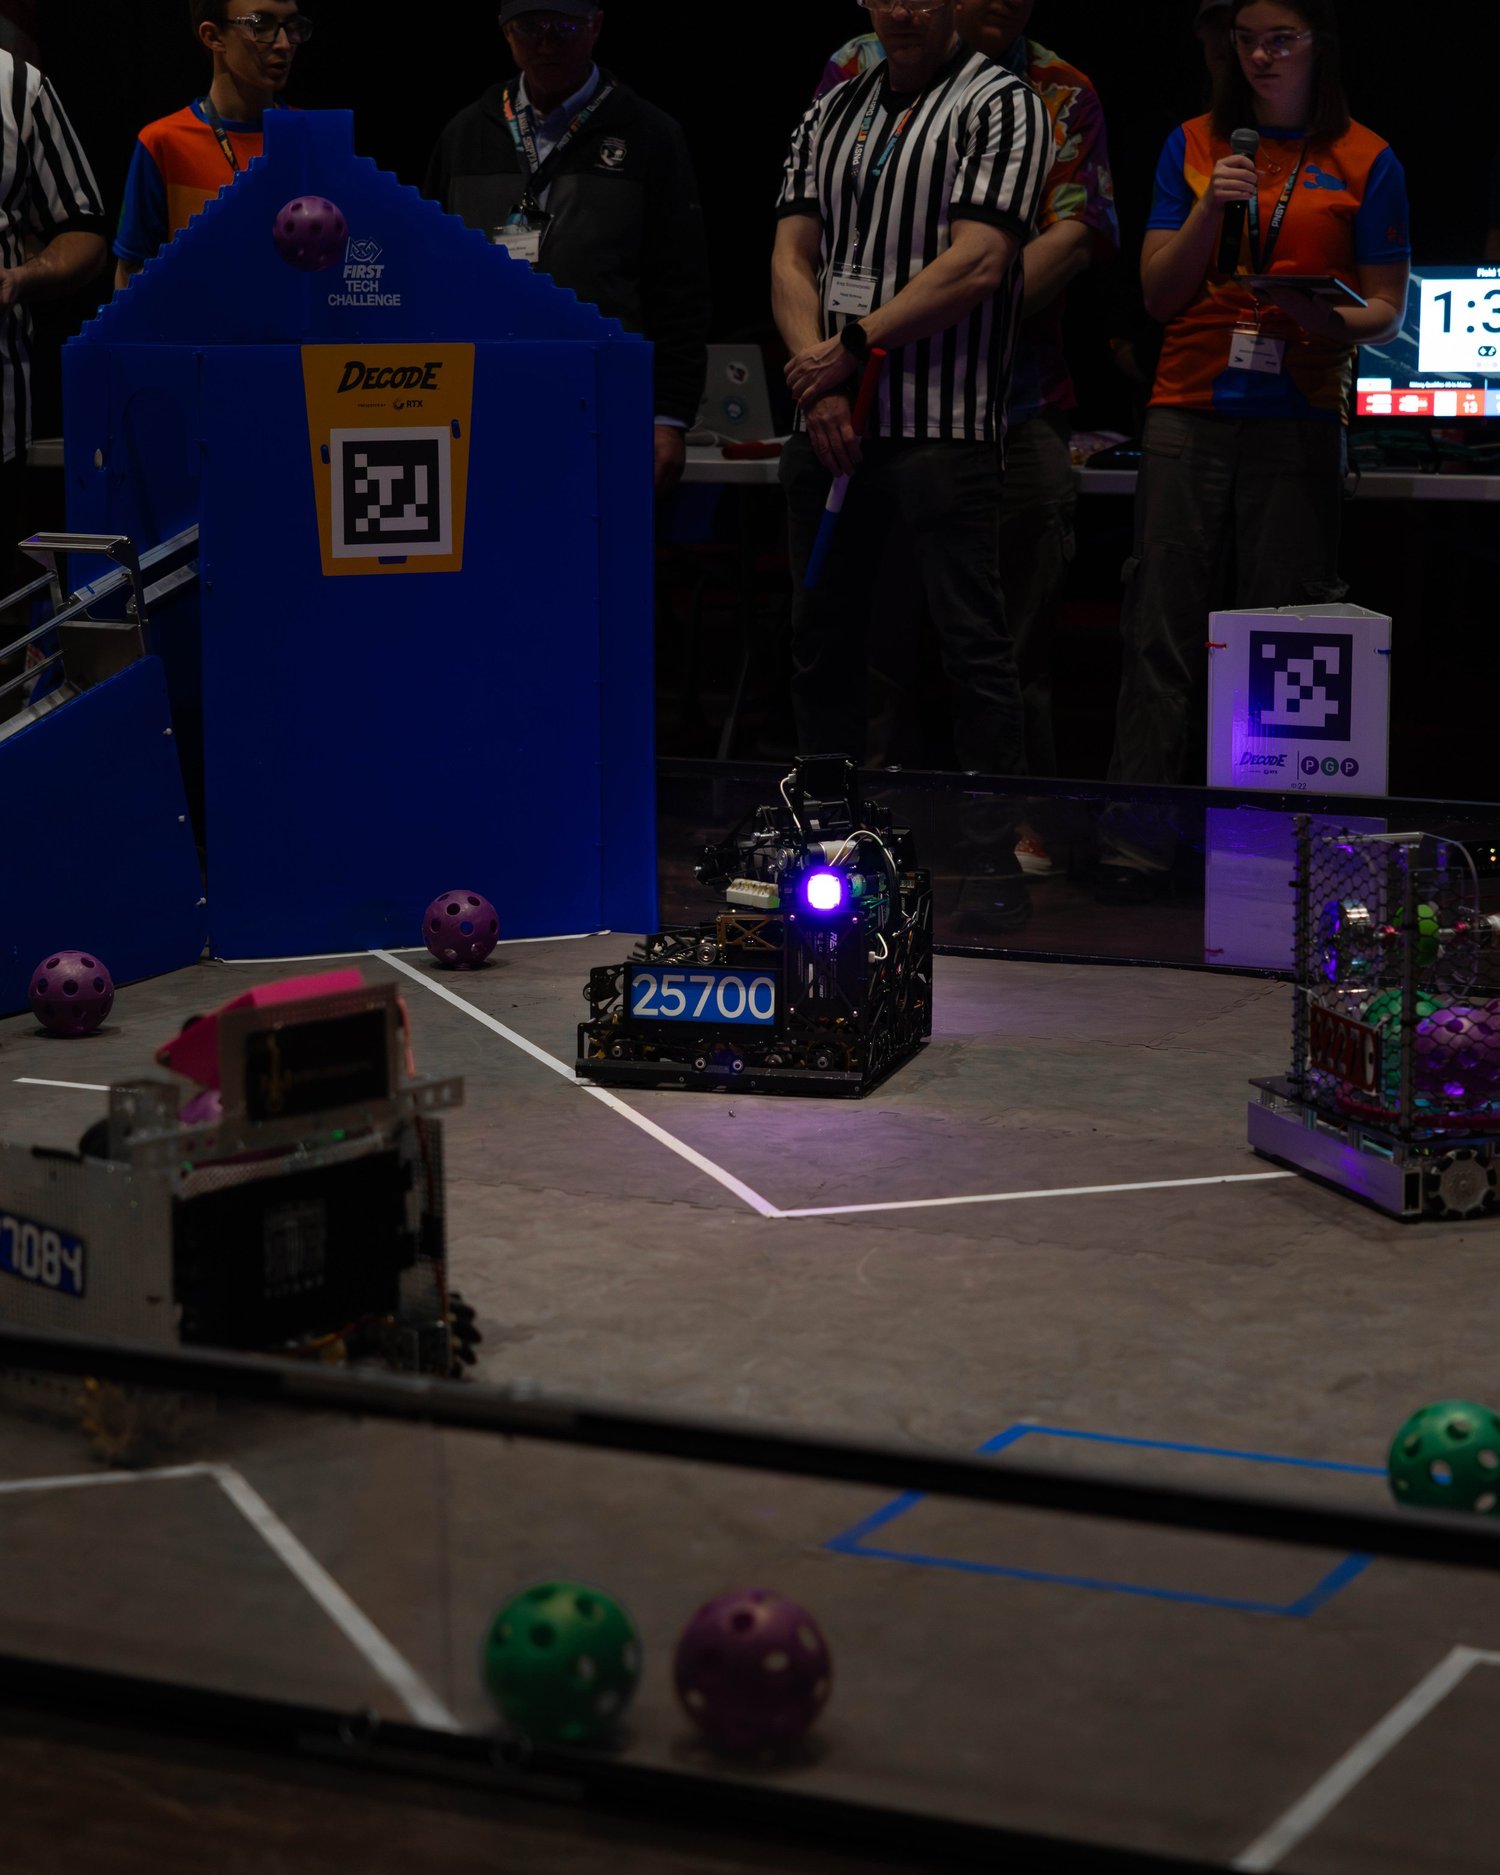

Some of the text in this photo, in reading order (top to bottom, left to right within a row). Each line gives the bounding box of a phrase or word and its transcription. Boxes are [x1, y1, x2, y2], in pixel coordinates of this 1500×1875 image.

[852, 142, 867, 166] PNSY
[343, 264, 385, 279] FIRST
[345, 280, 379, 293] TECH
[327, 293, 402, 307] CHALLENGE
[337, 360, 443, 394] DECODE
[406, 399, 424, 408] RTX
[1240, 752, 1287, 767] DECODE
[631, 973, 776, 1020] 25700
[0, 1215, 83, 1293] 7084
